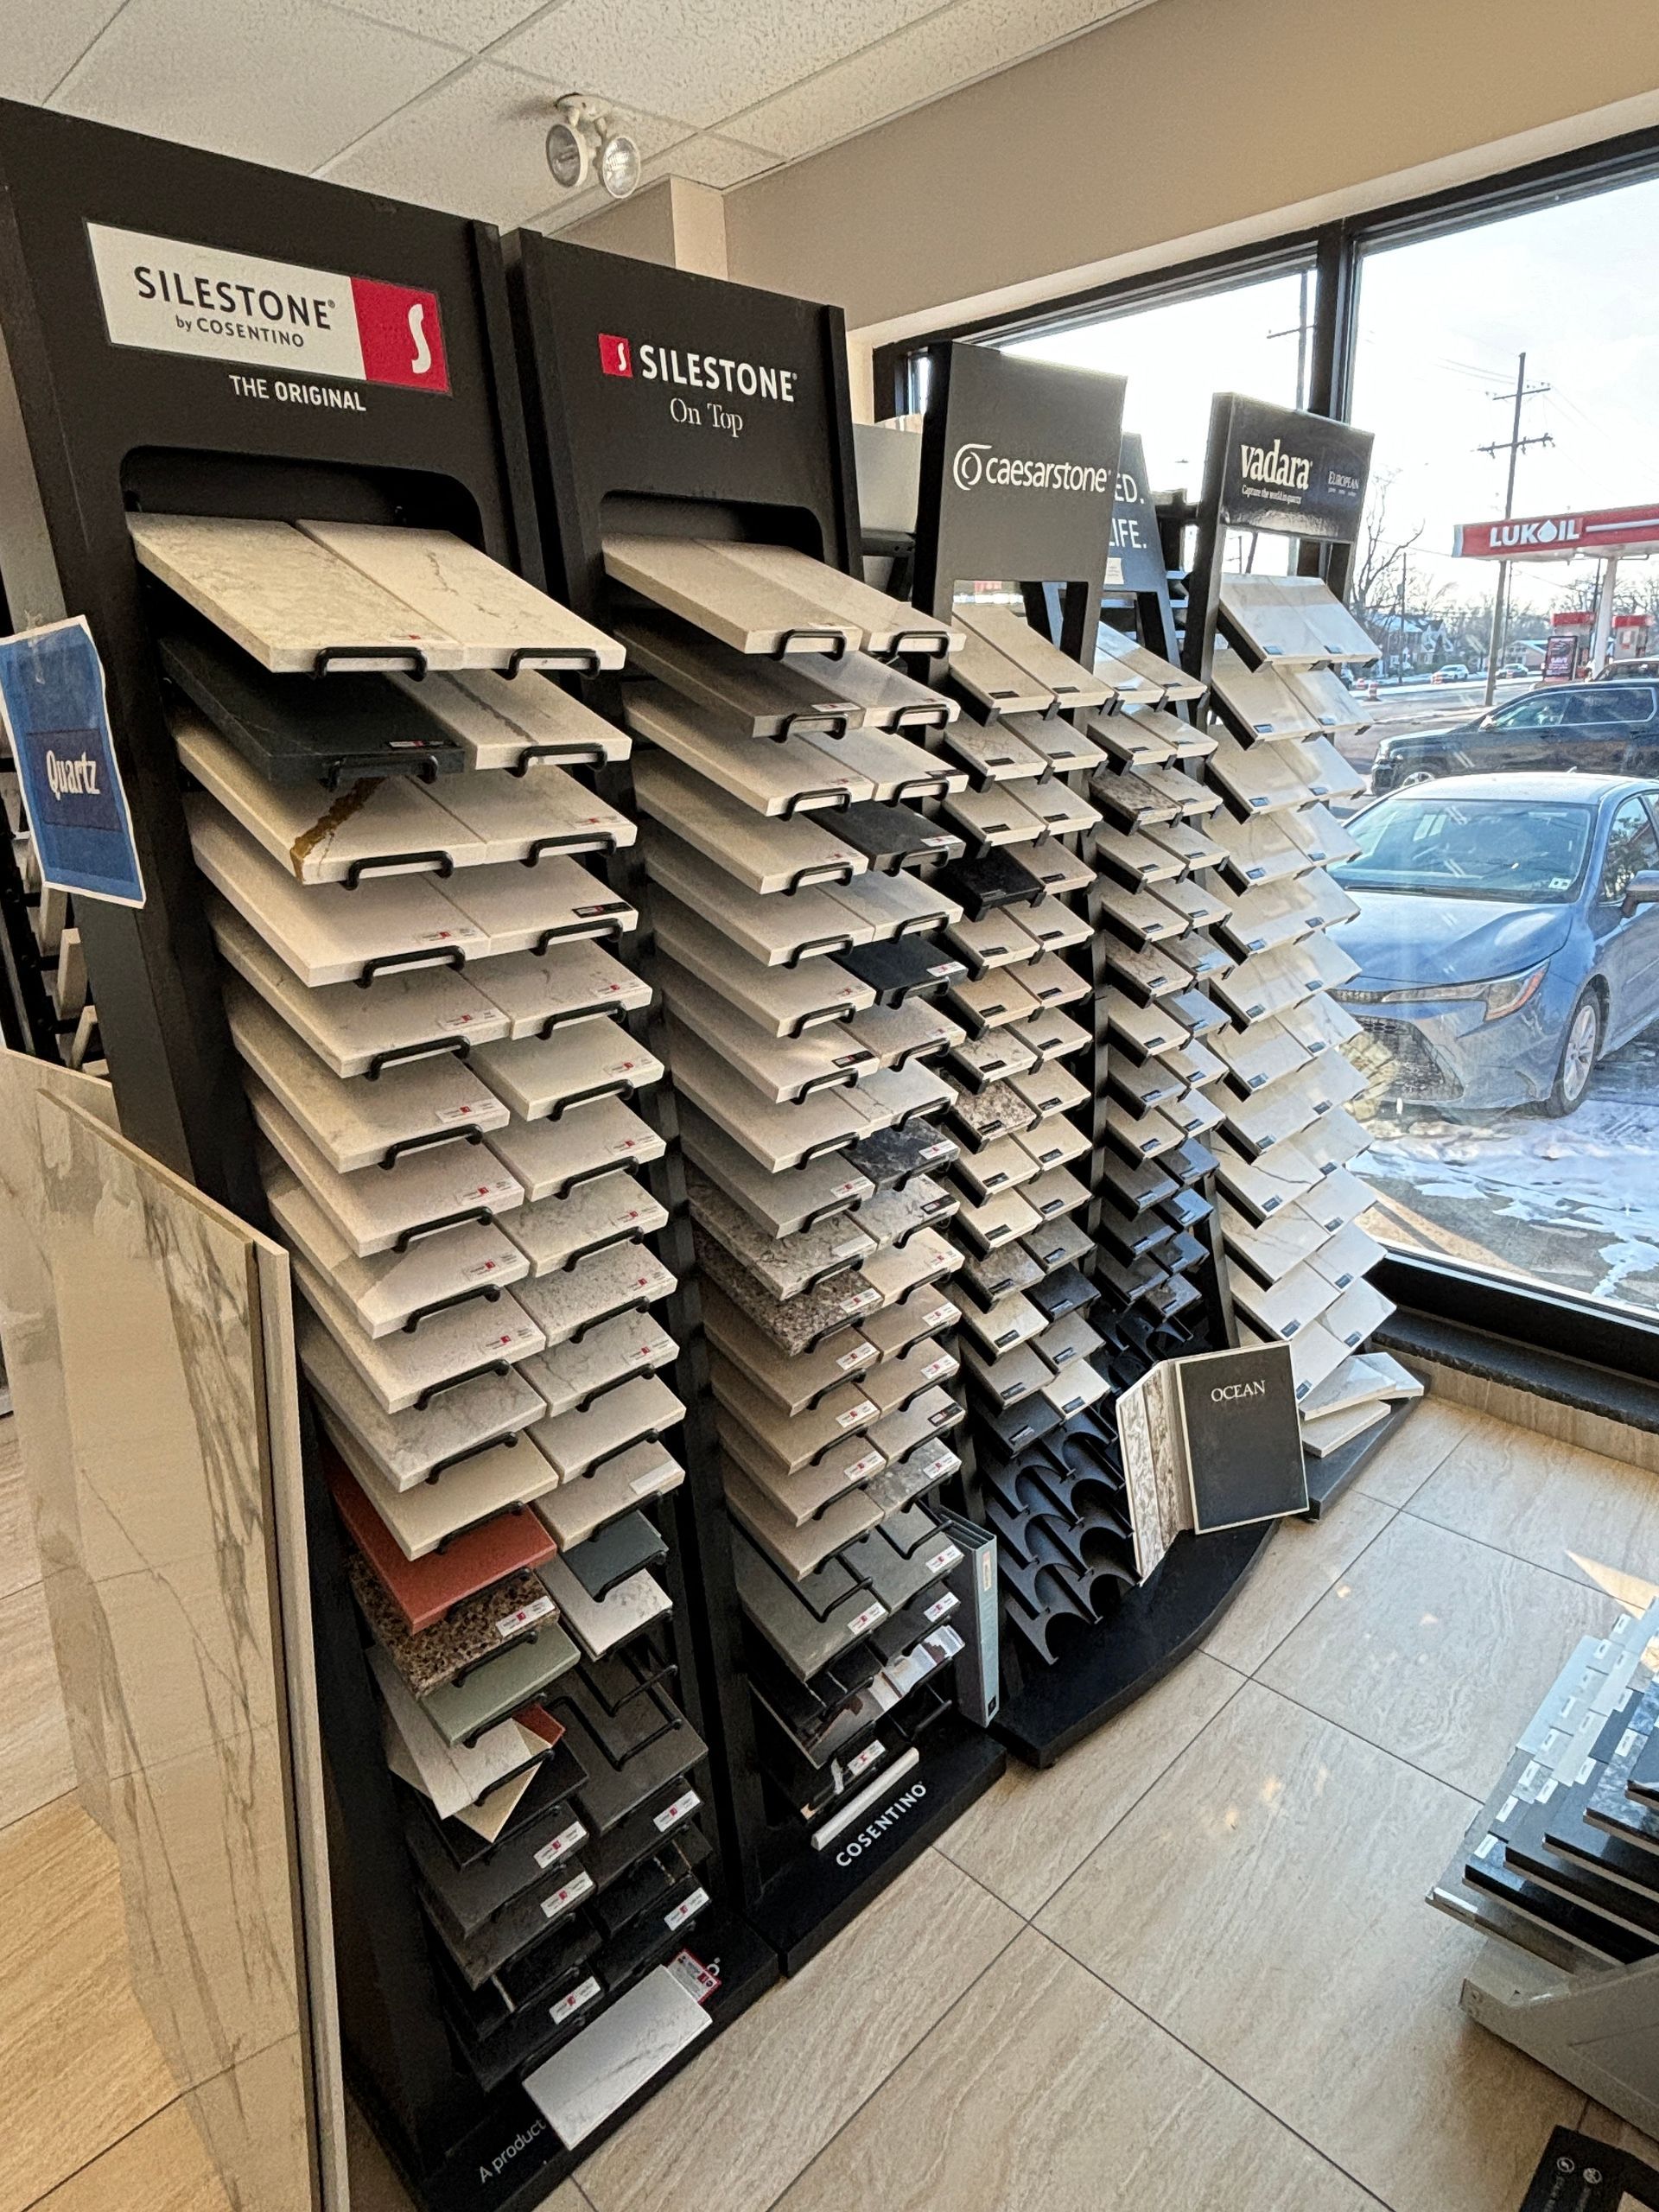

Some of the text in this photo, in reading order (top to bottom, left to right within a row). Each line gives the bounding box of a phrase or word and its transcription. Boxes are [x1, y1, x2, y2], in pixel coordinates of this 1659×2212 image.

[175, 315, 304, 348] by COSENTINO
[229, 374, 367, 412] THE ORIGINAL
[670, 397, 744, 438] On Top
[985, 457, 1109, 493] caesarstone
[1241, 439, 1310, 491] vadara
[1490, 519, 1580, 548] LUKOIL
[46, 750, 100, 801] Quartz
[1211, 1379, 1266, 1402] OCEAN
[836, 1783, 927, 1867] COSENTINO
[480, 2119, 547, 2184] A product
